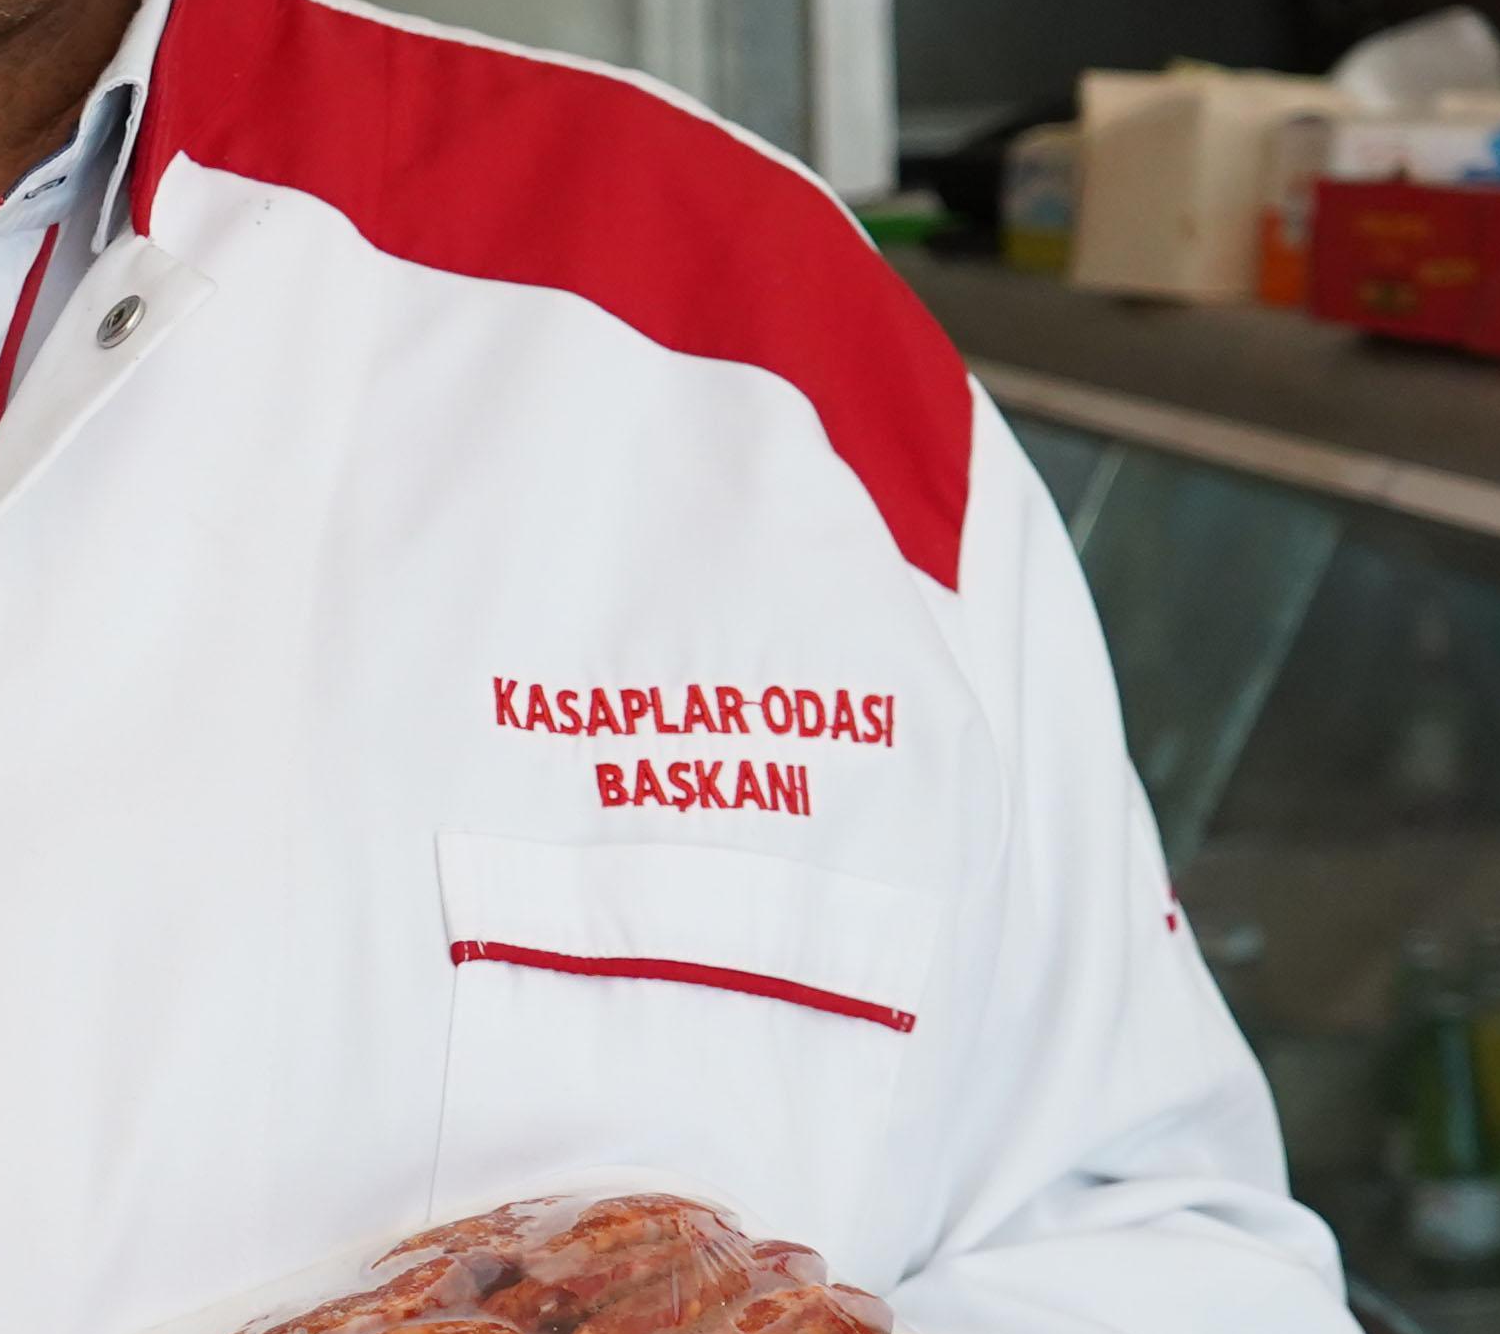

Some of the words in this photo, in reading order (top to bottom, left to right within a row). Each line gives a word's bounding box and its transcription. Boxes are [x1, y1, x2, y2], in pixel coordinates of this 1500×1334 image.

[493, 676, 752, 737] KASAPLAR
[760, 685, 894, 748] ODASI
[595, 758, 812, 817] BAŞKANI
